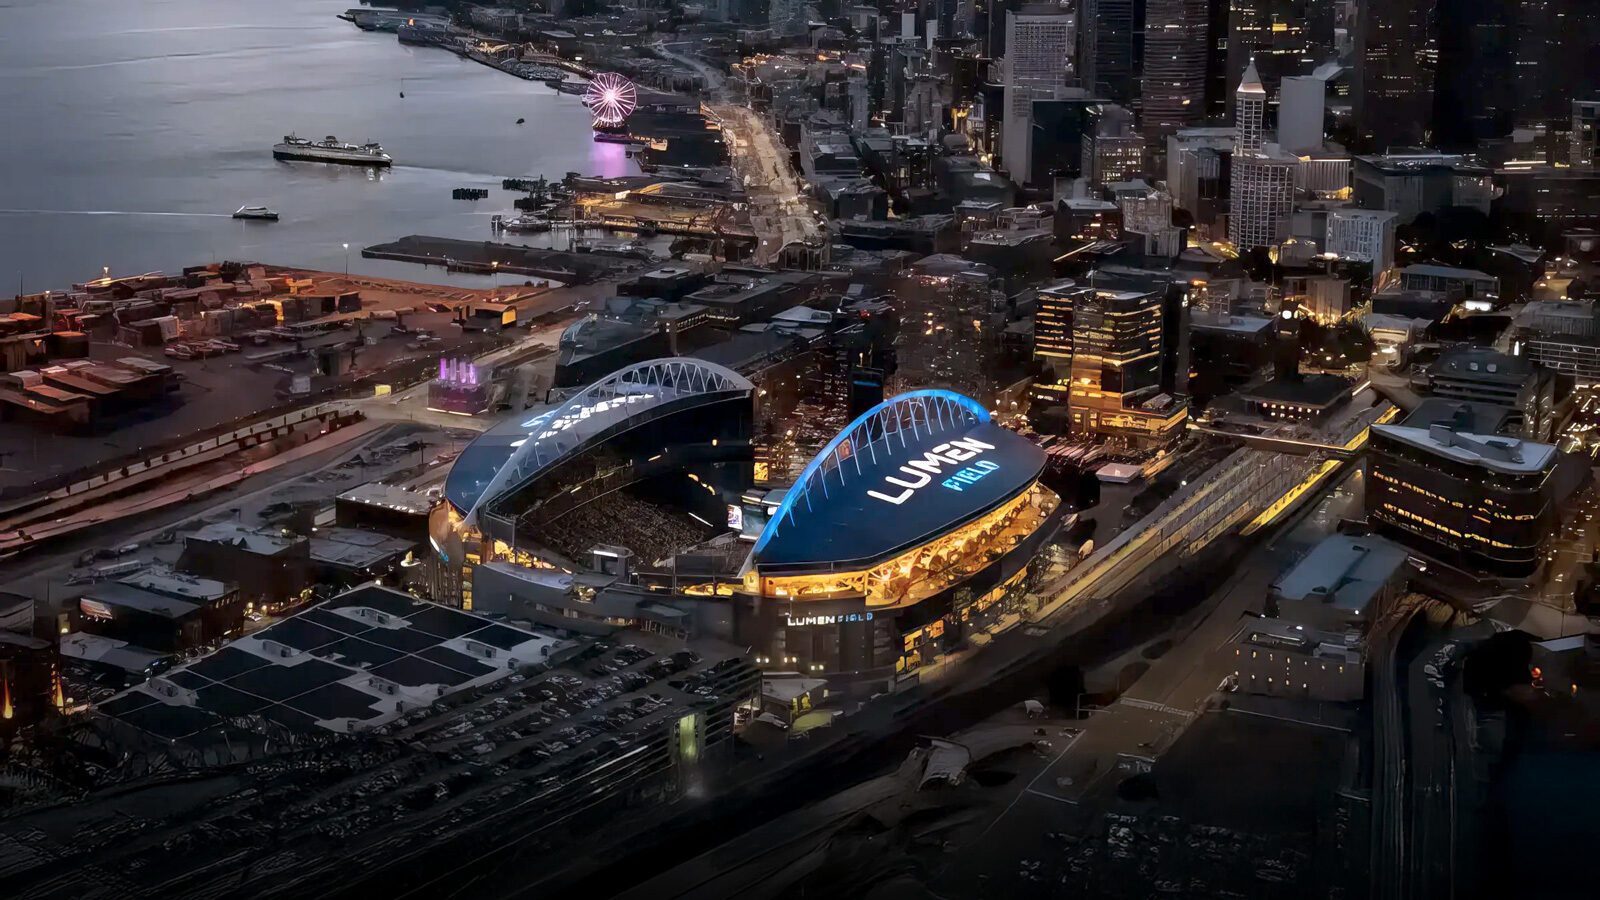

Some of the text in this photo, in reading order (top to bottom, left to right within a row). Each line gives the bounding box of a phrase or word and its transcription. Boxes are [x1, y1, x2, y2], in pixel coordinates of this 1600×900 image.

[867, 436, 996, 505] LUMEN
[941, 459, 1000, 492] FIELD
[787, 615, 836, 626] LUMEN
